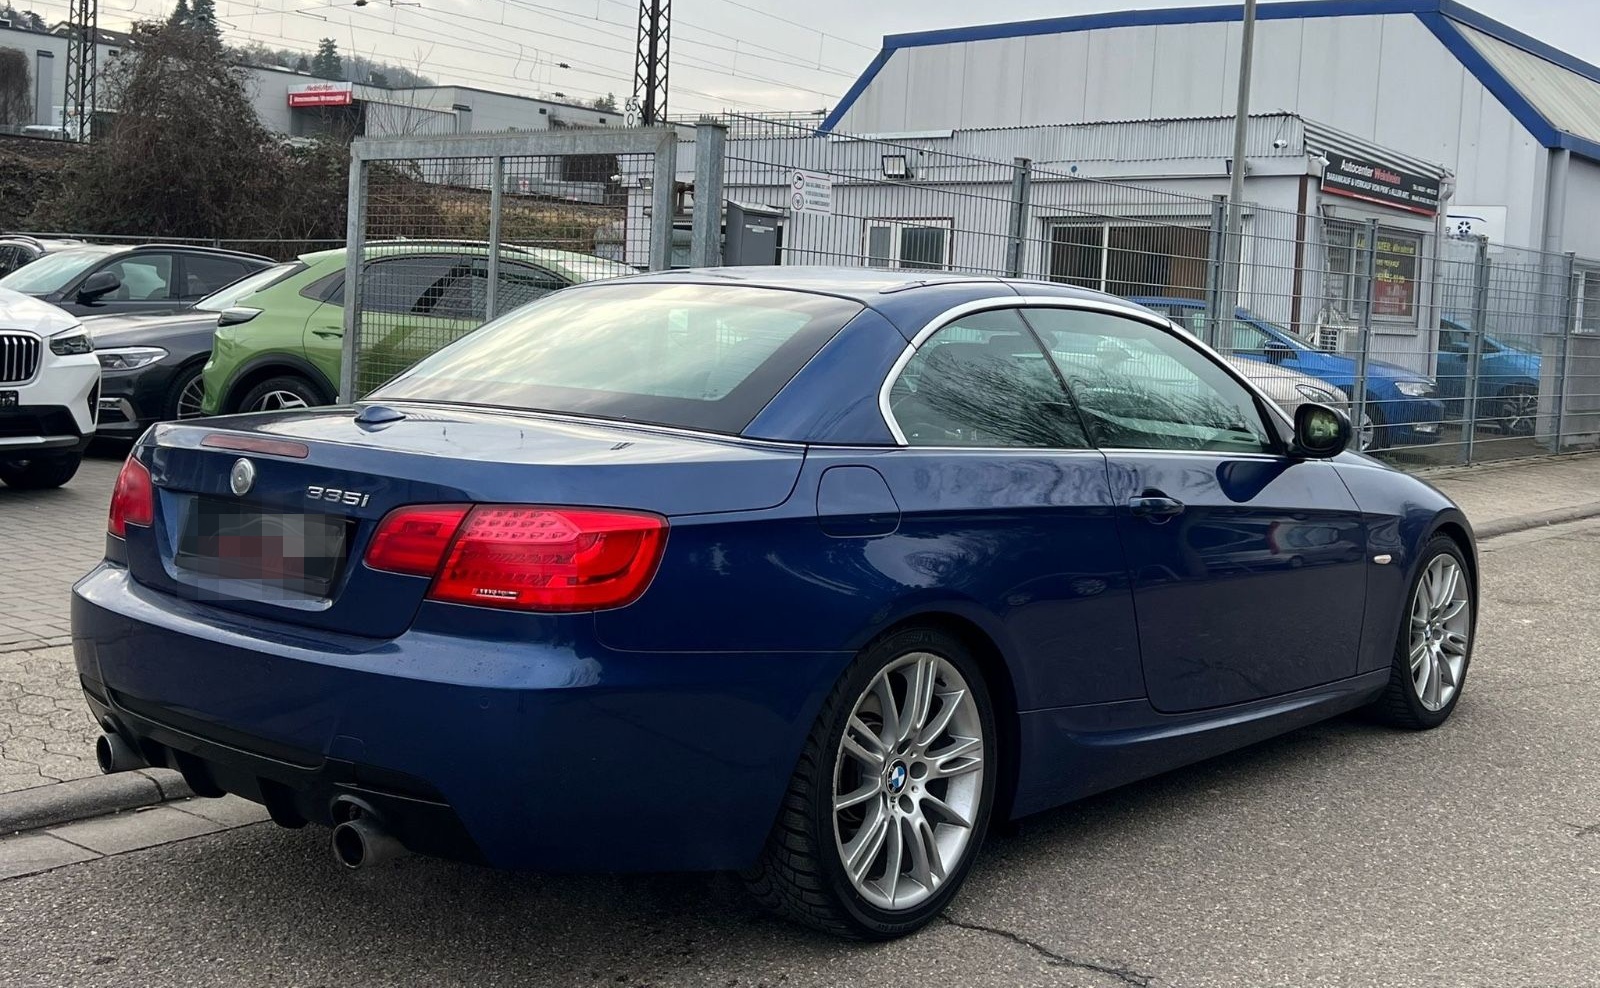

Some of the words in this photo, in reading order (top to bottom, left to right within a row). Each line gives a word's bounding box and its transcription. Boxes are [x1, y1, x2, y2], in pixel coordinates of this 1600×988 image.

[625, 98, 637, 111] 65
[627, 113, 634, 125] 0
[1341, 159, 1374, 177] Autocenter
[1374, 167, 1401, 184] Weinheim
